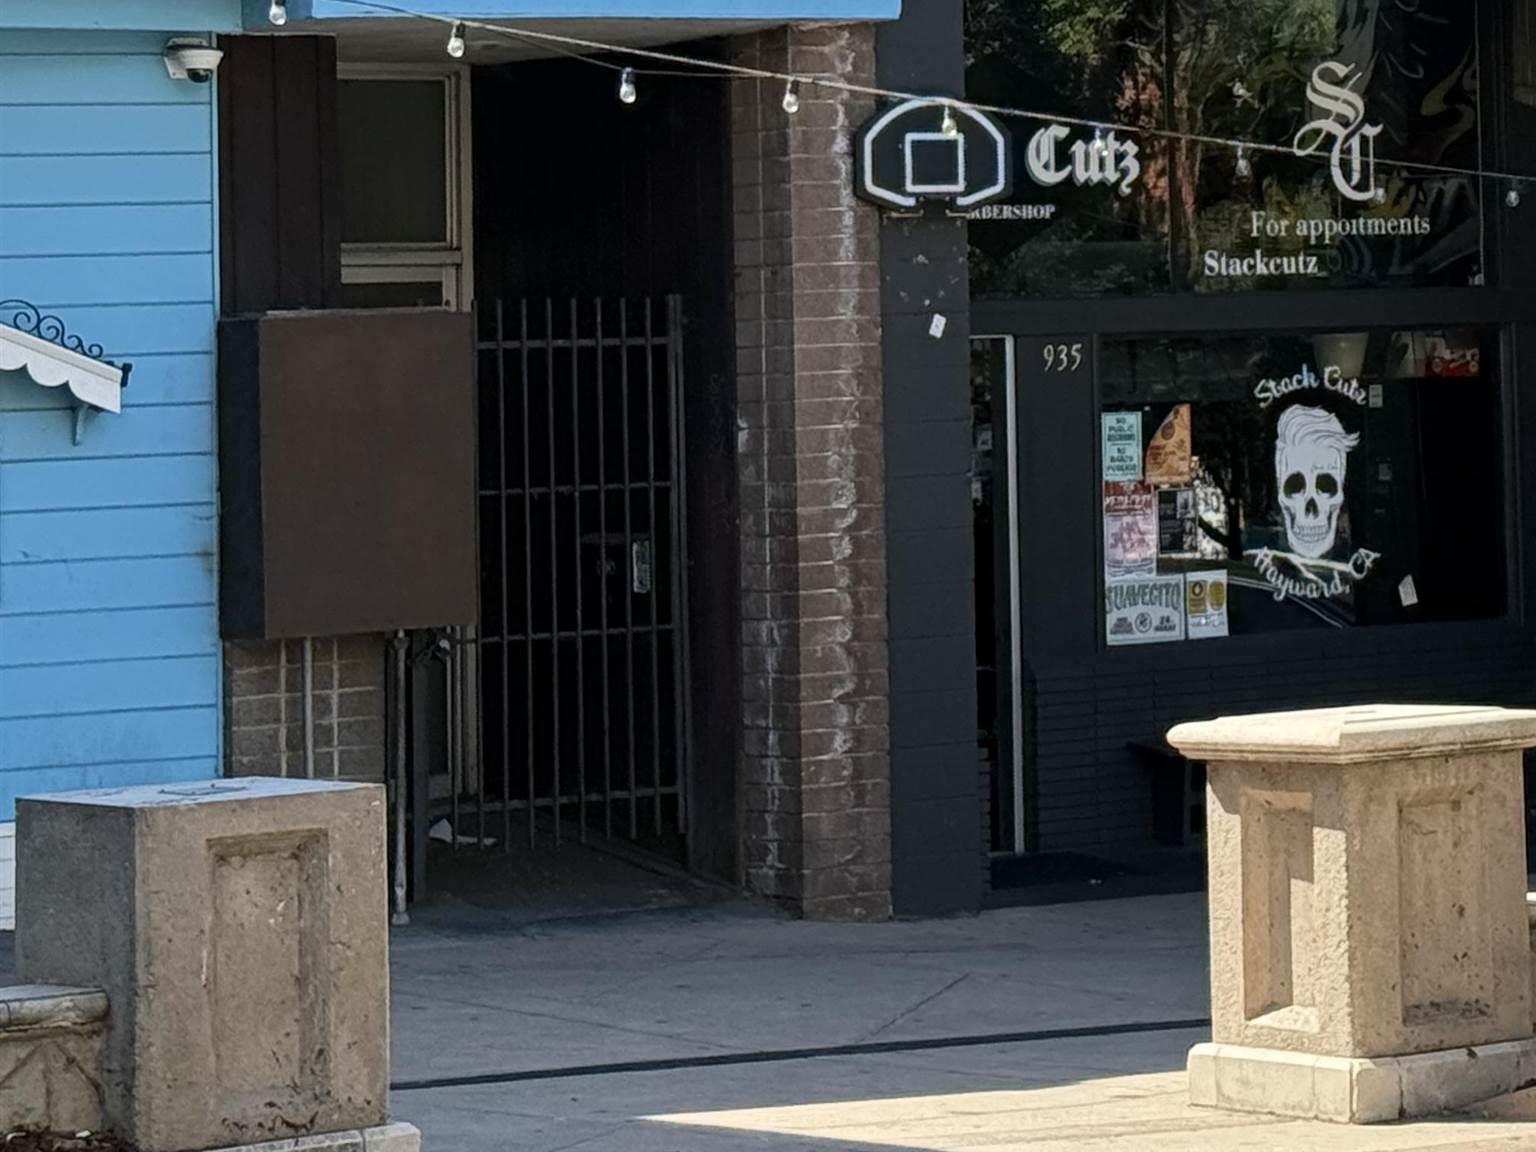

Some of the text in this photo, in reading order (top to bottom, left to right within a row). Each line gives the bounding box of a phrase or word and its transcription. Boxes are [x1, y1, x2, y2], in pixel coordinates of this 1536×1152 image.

[1025, 123, 1140, 197] Cutz
[1250, 211, 1289, 237] For
[1042, 343, 1083, 372] 935
